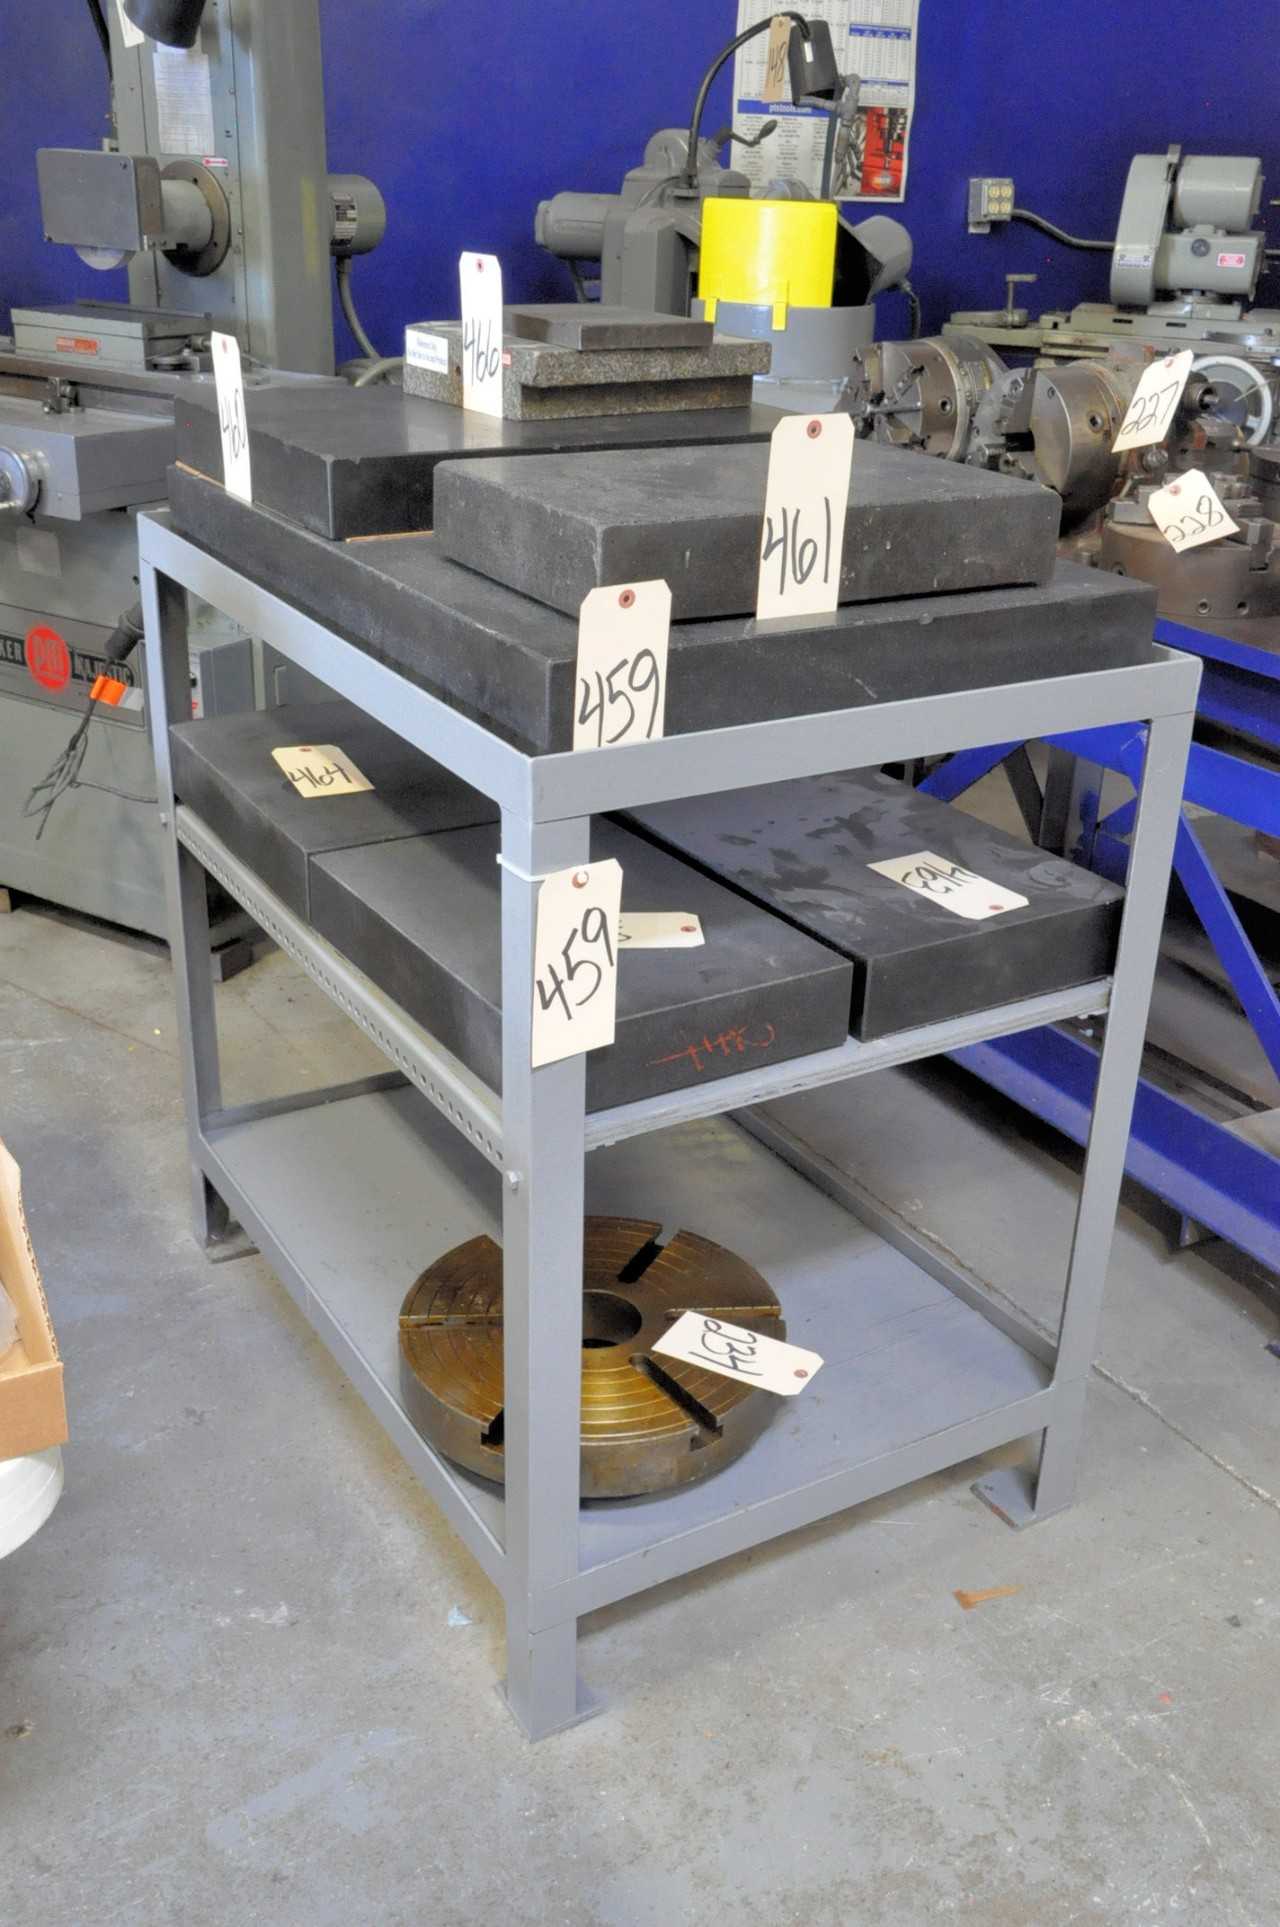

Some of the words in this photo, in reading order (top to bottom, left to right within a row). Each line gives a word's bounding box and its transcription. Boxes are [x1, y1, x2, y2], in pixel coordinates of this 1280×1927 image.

[463, 316, 499, 388] 466
[1119, 379, 1181, 436] 227
[762, 496, 831, 595] 461
[1162, 494, 1225, 543] 228
[577, 648, 660, 748] 459
[287, 762, 352, 789] 464
[901, 861, 979, 893] 463
[536, 906, 615, 1020] 459
[688, 1318, 764, 1377] 234
